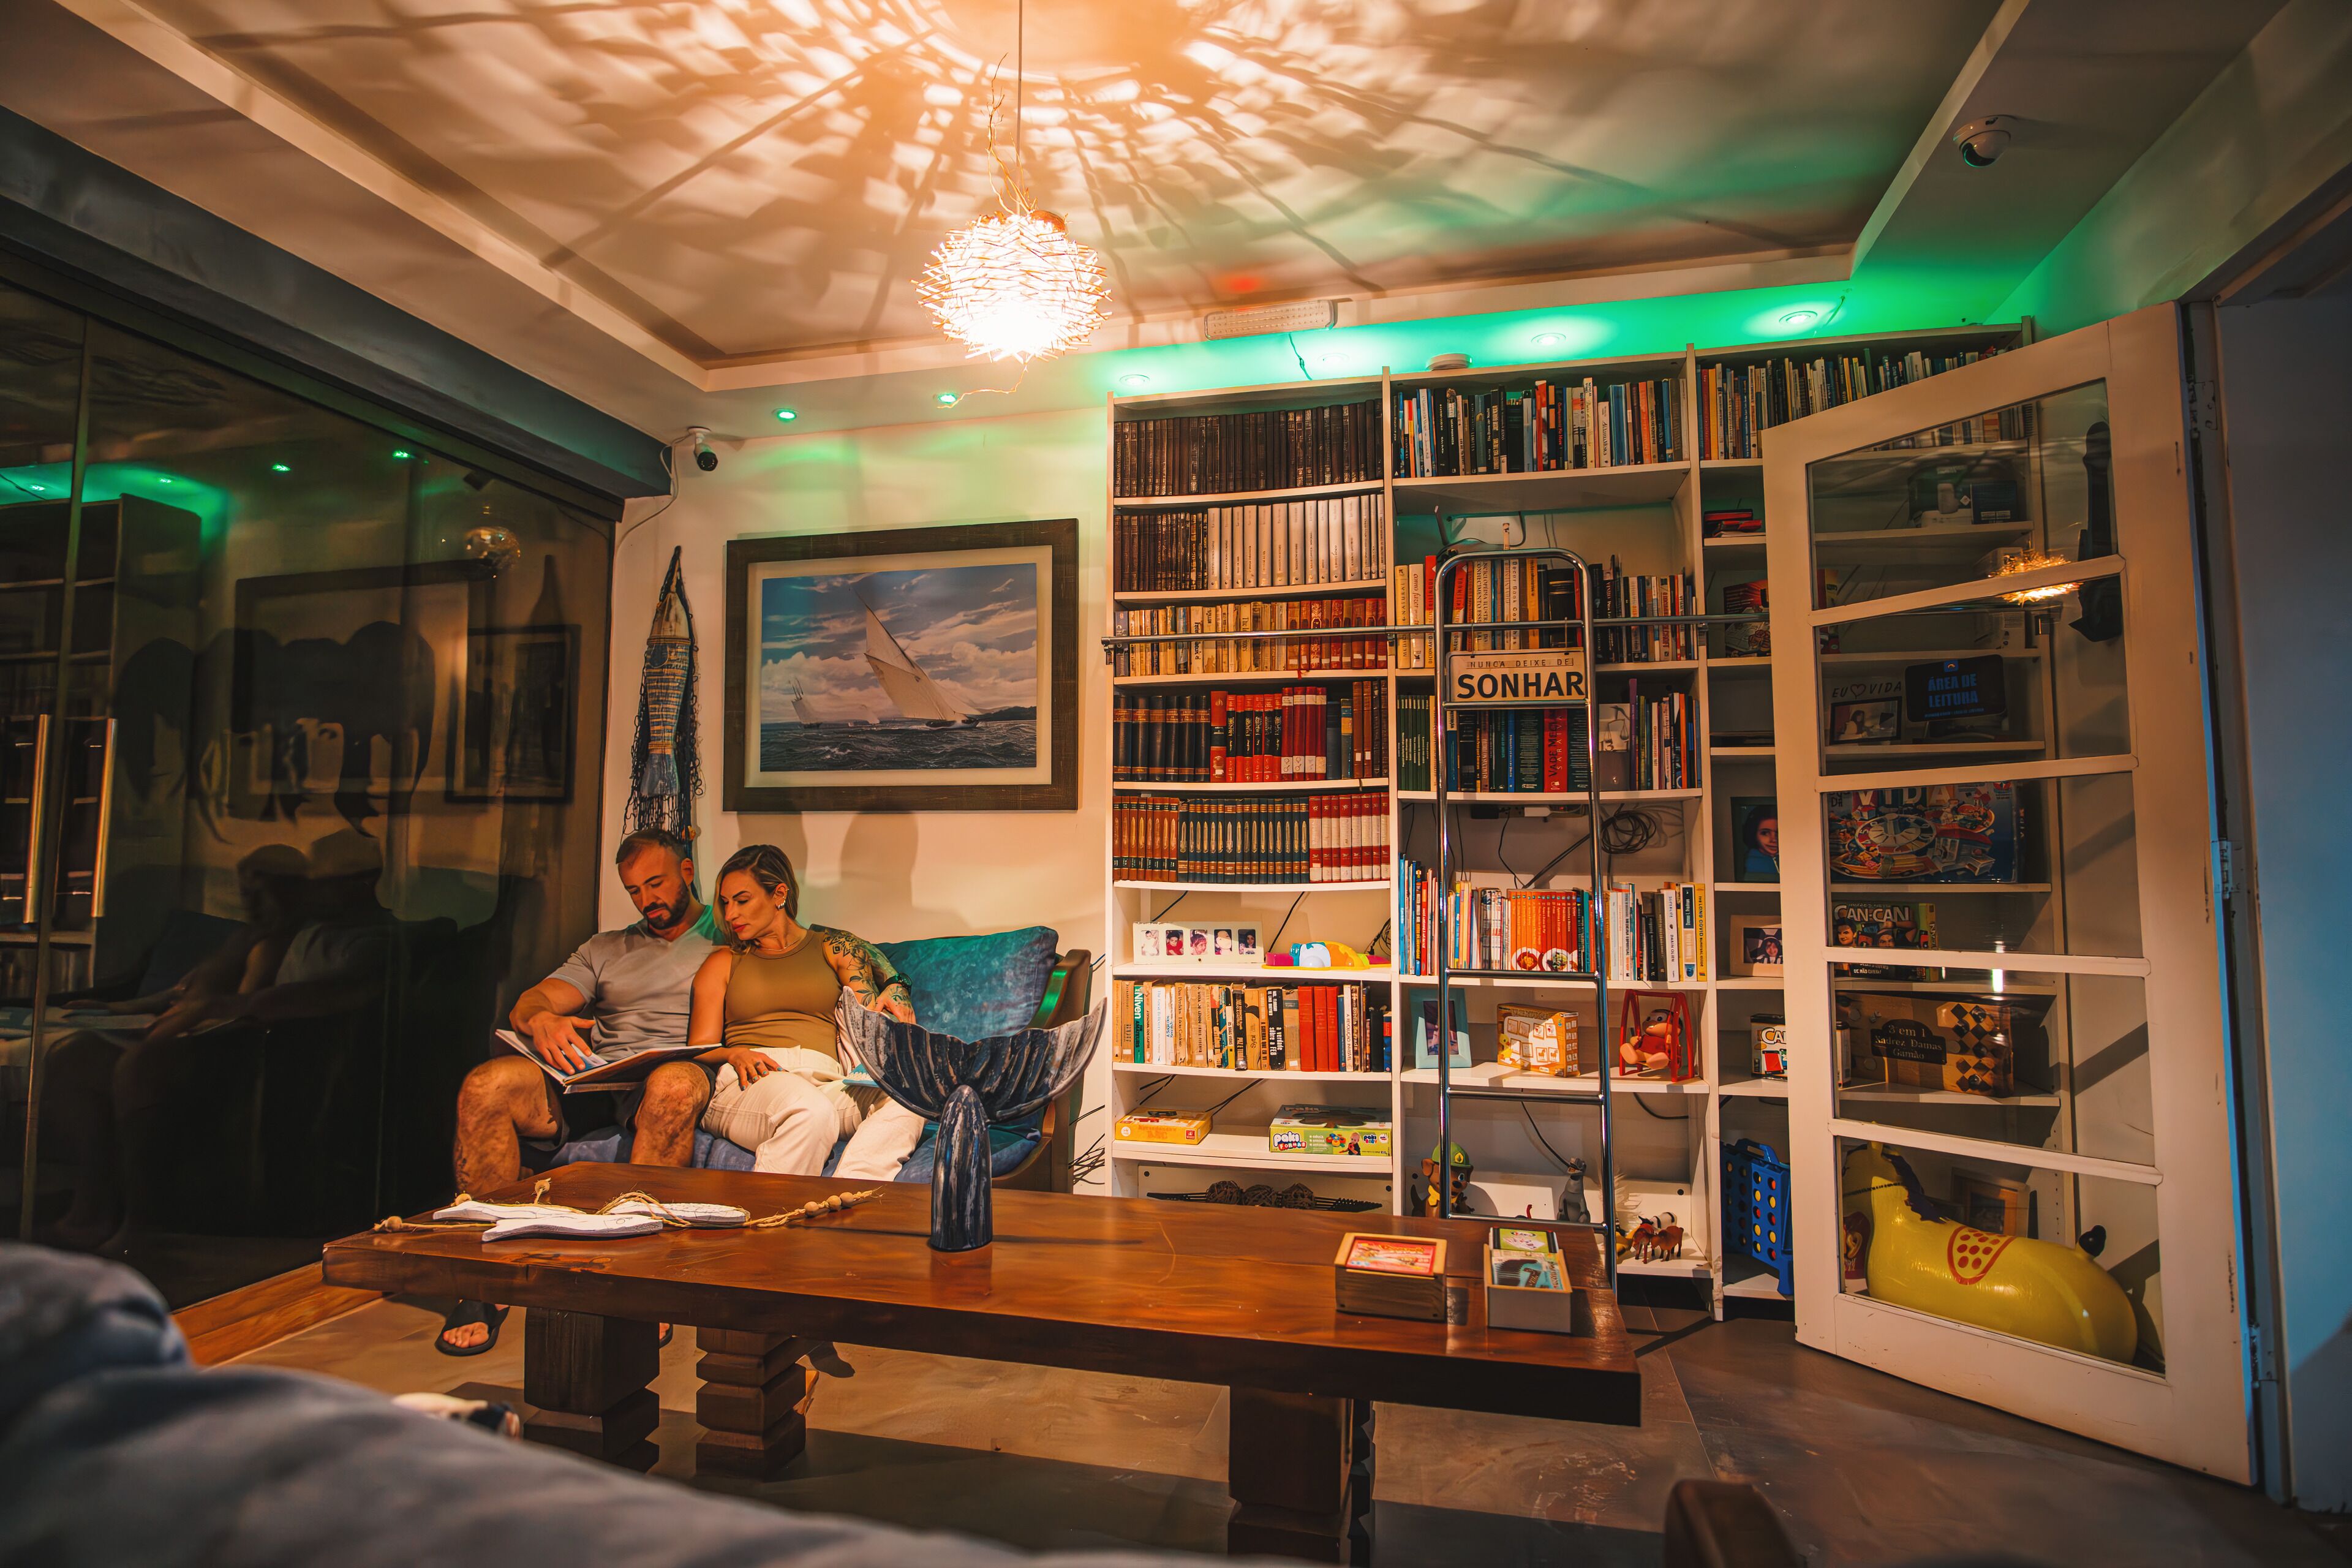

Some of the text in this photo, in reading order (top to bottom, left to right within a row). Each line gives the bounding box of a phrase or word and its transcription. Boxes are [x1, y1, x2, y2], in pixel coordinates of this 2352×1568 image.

[1412, 592, 1421, 608] fazer
[1457, 671, 1585, 699] SONHAR
[1833, 682, 1901, 698] EU VIDA
[1928, 673, 1977, 692] ÁREA DE
[1929, 690, 1978, 707] LEITURA
[1548, 750, 1558, 777] VADE
[1834, 905, 1910, 922] CAN-CAN
[1134, 992, 1143, 1019] Niven
[1761, 1027, 1787, 1045] CA
[1888, 1025, 1896, 1035] 3
[1922, 1028, 1926, 1037] 1
[1875, 1035, 1942, 1050] Xadrez Damas
[1893, 1048, 1924, 1059] Gamão
[1273, 1131, 1300, 1148] paki
[1278, 1141, 1306, 1151] FORMAS
